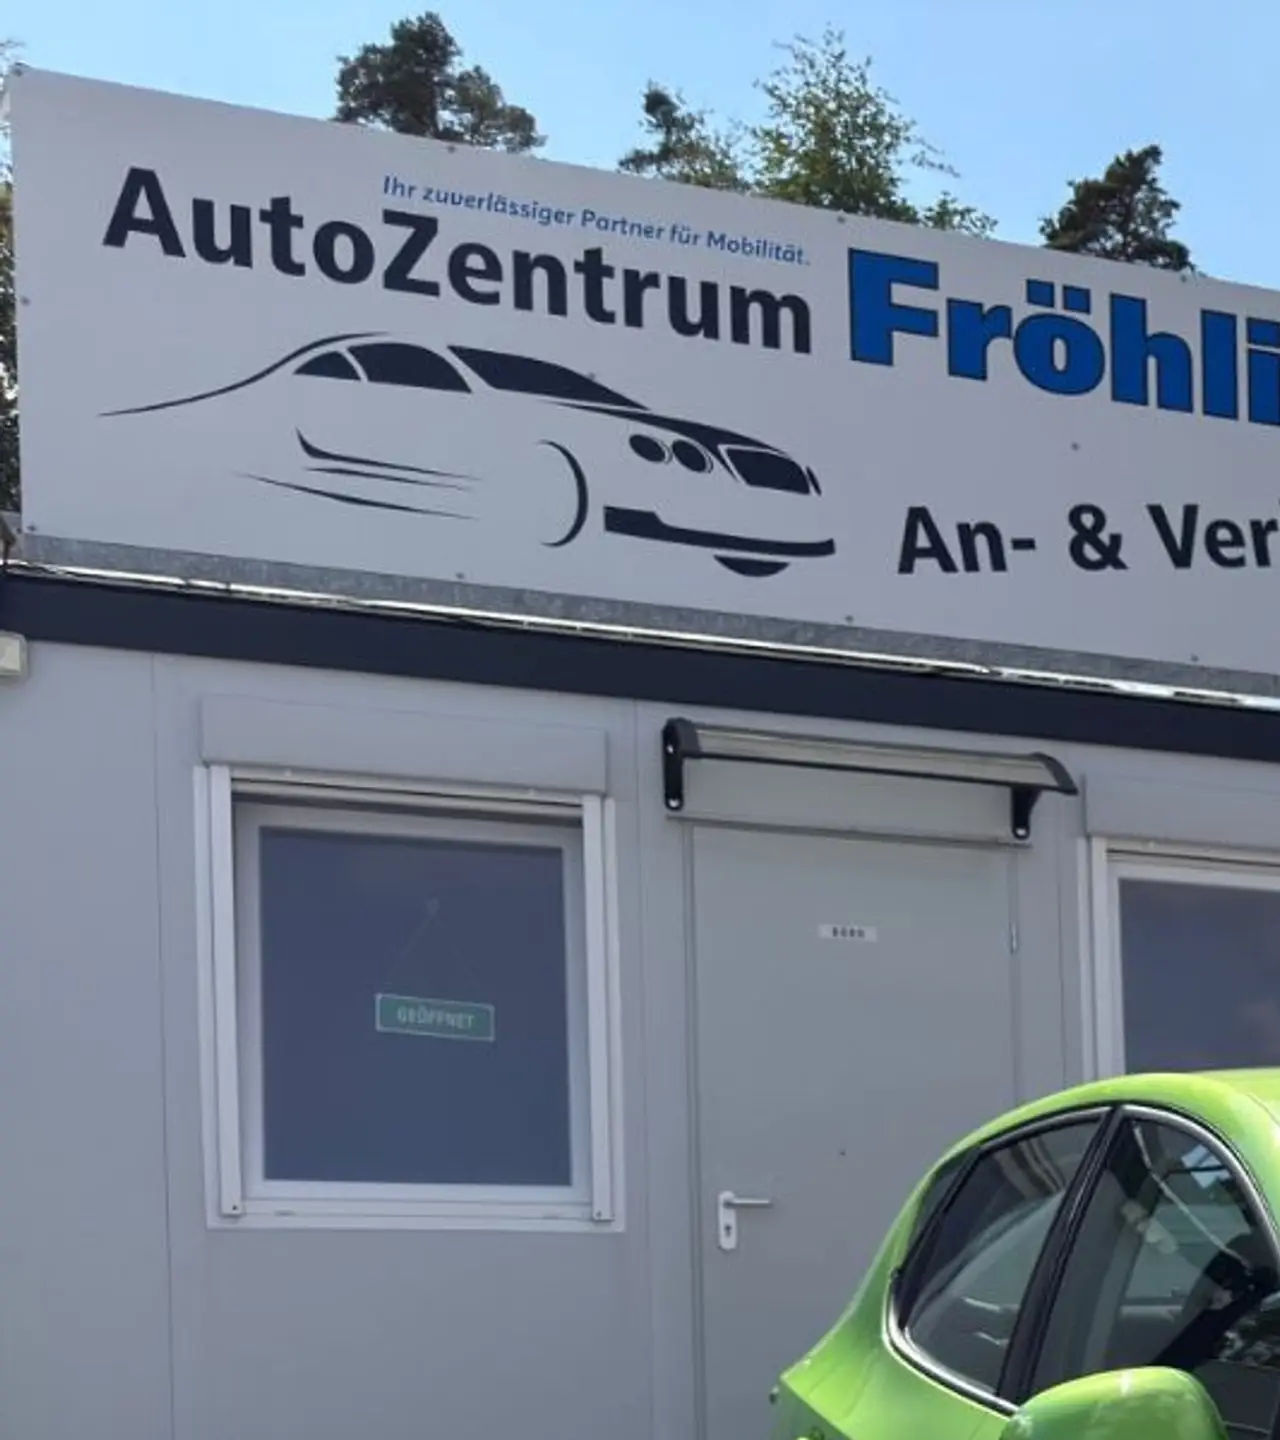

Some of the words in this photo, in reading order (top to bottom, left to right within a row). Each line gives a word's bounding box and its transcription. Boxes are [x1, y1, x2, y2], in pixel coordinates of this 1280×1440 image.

[384, 175, 416, 199] Ihr
[423, 188, 575, 228] zuverlässiger
[581, 208, 665, 240] Partner
[670, 223, 701, 246] für
[102, 166, 812, 355] AutoZentrum
[898, 505, 1036, 574] An-
[1067, 502, 1128, 571] &
[397, 1004, 475, 1030] GEÖFFNET
